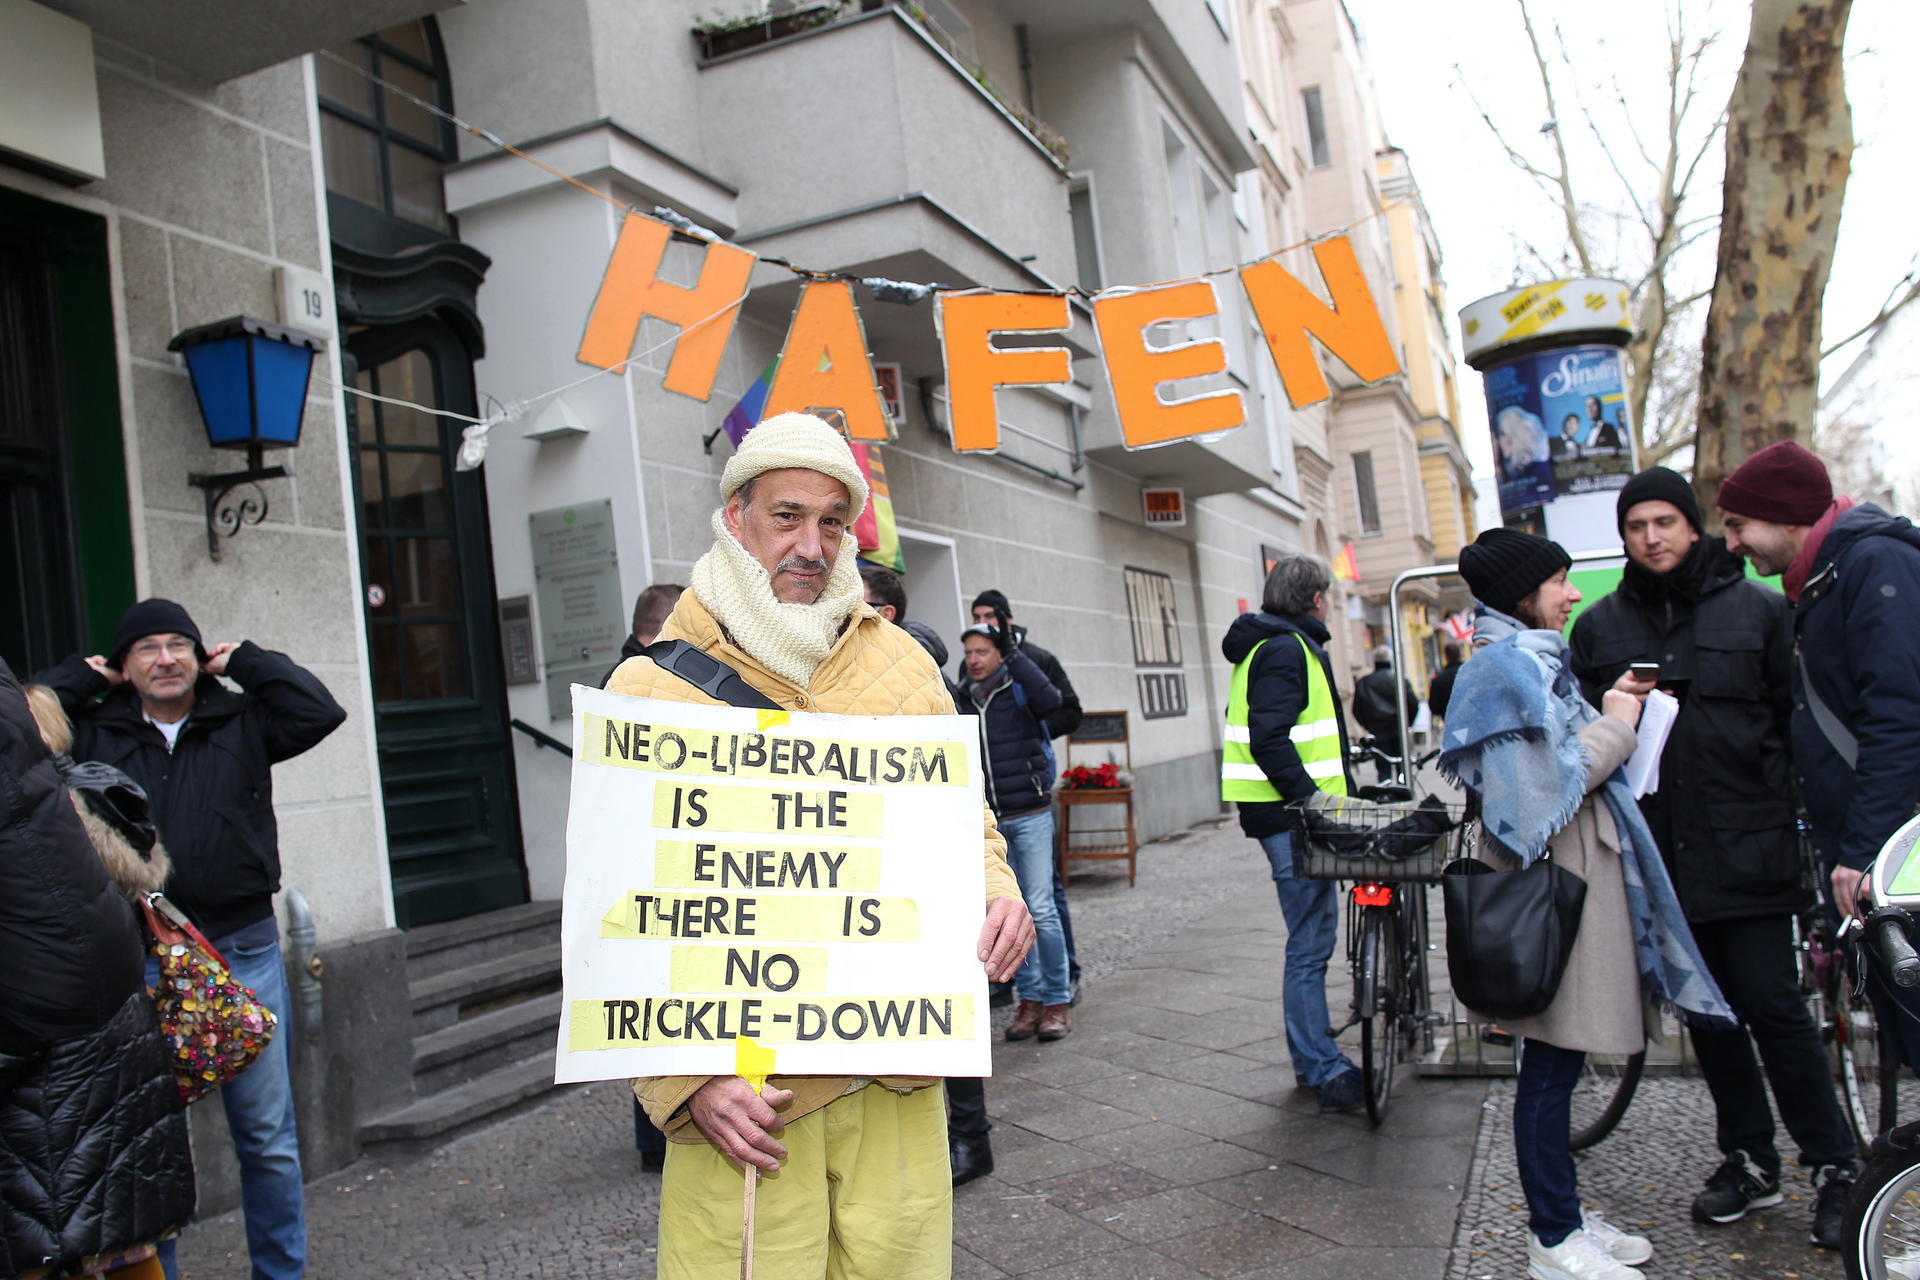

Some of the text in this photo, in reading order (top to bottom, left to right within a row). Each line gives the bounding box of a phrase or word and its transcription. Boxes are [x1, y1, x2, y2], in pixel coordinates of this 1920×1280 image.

[303, 288, 322, 318] 19
[576, 212, 1401, 454] HAFEN
[605, 719, 949, 785] NEO-LIBERALISM
[672, 787, 848, 830] IS THE
[694, 843, 848, 889] ENEMY
[634, 895, 882, 938] THERE IS
[724, 947, 801, 992] NO
[603, 997, 953, 1042] TRICKLE-DOWN
